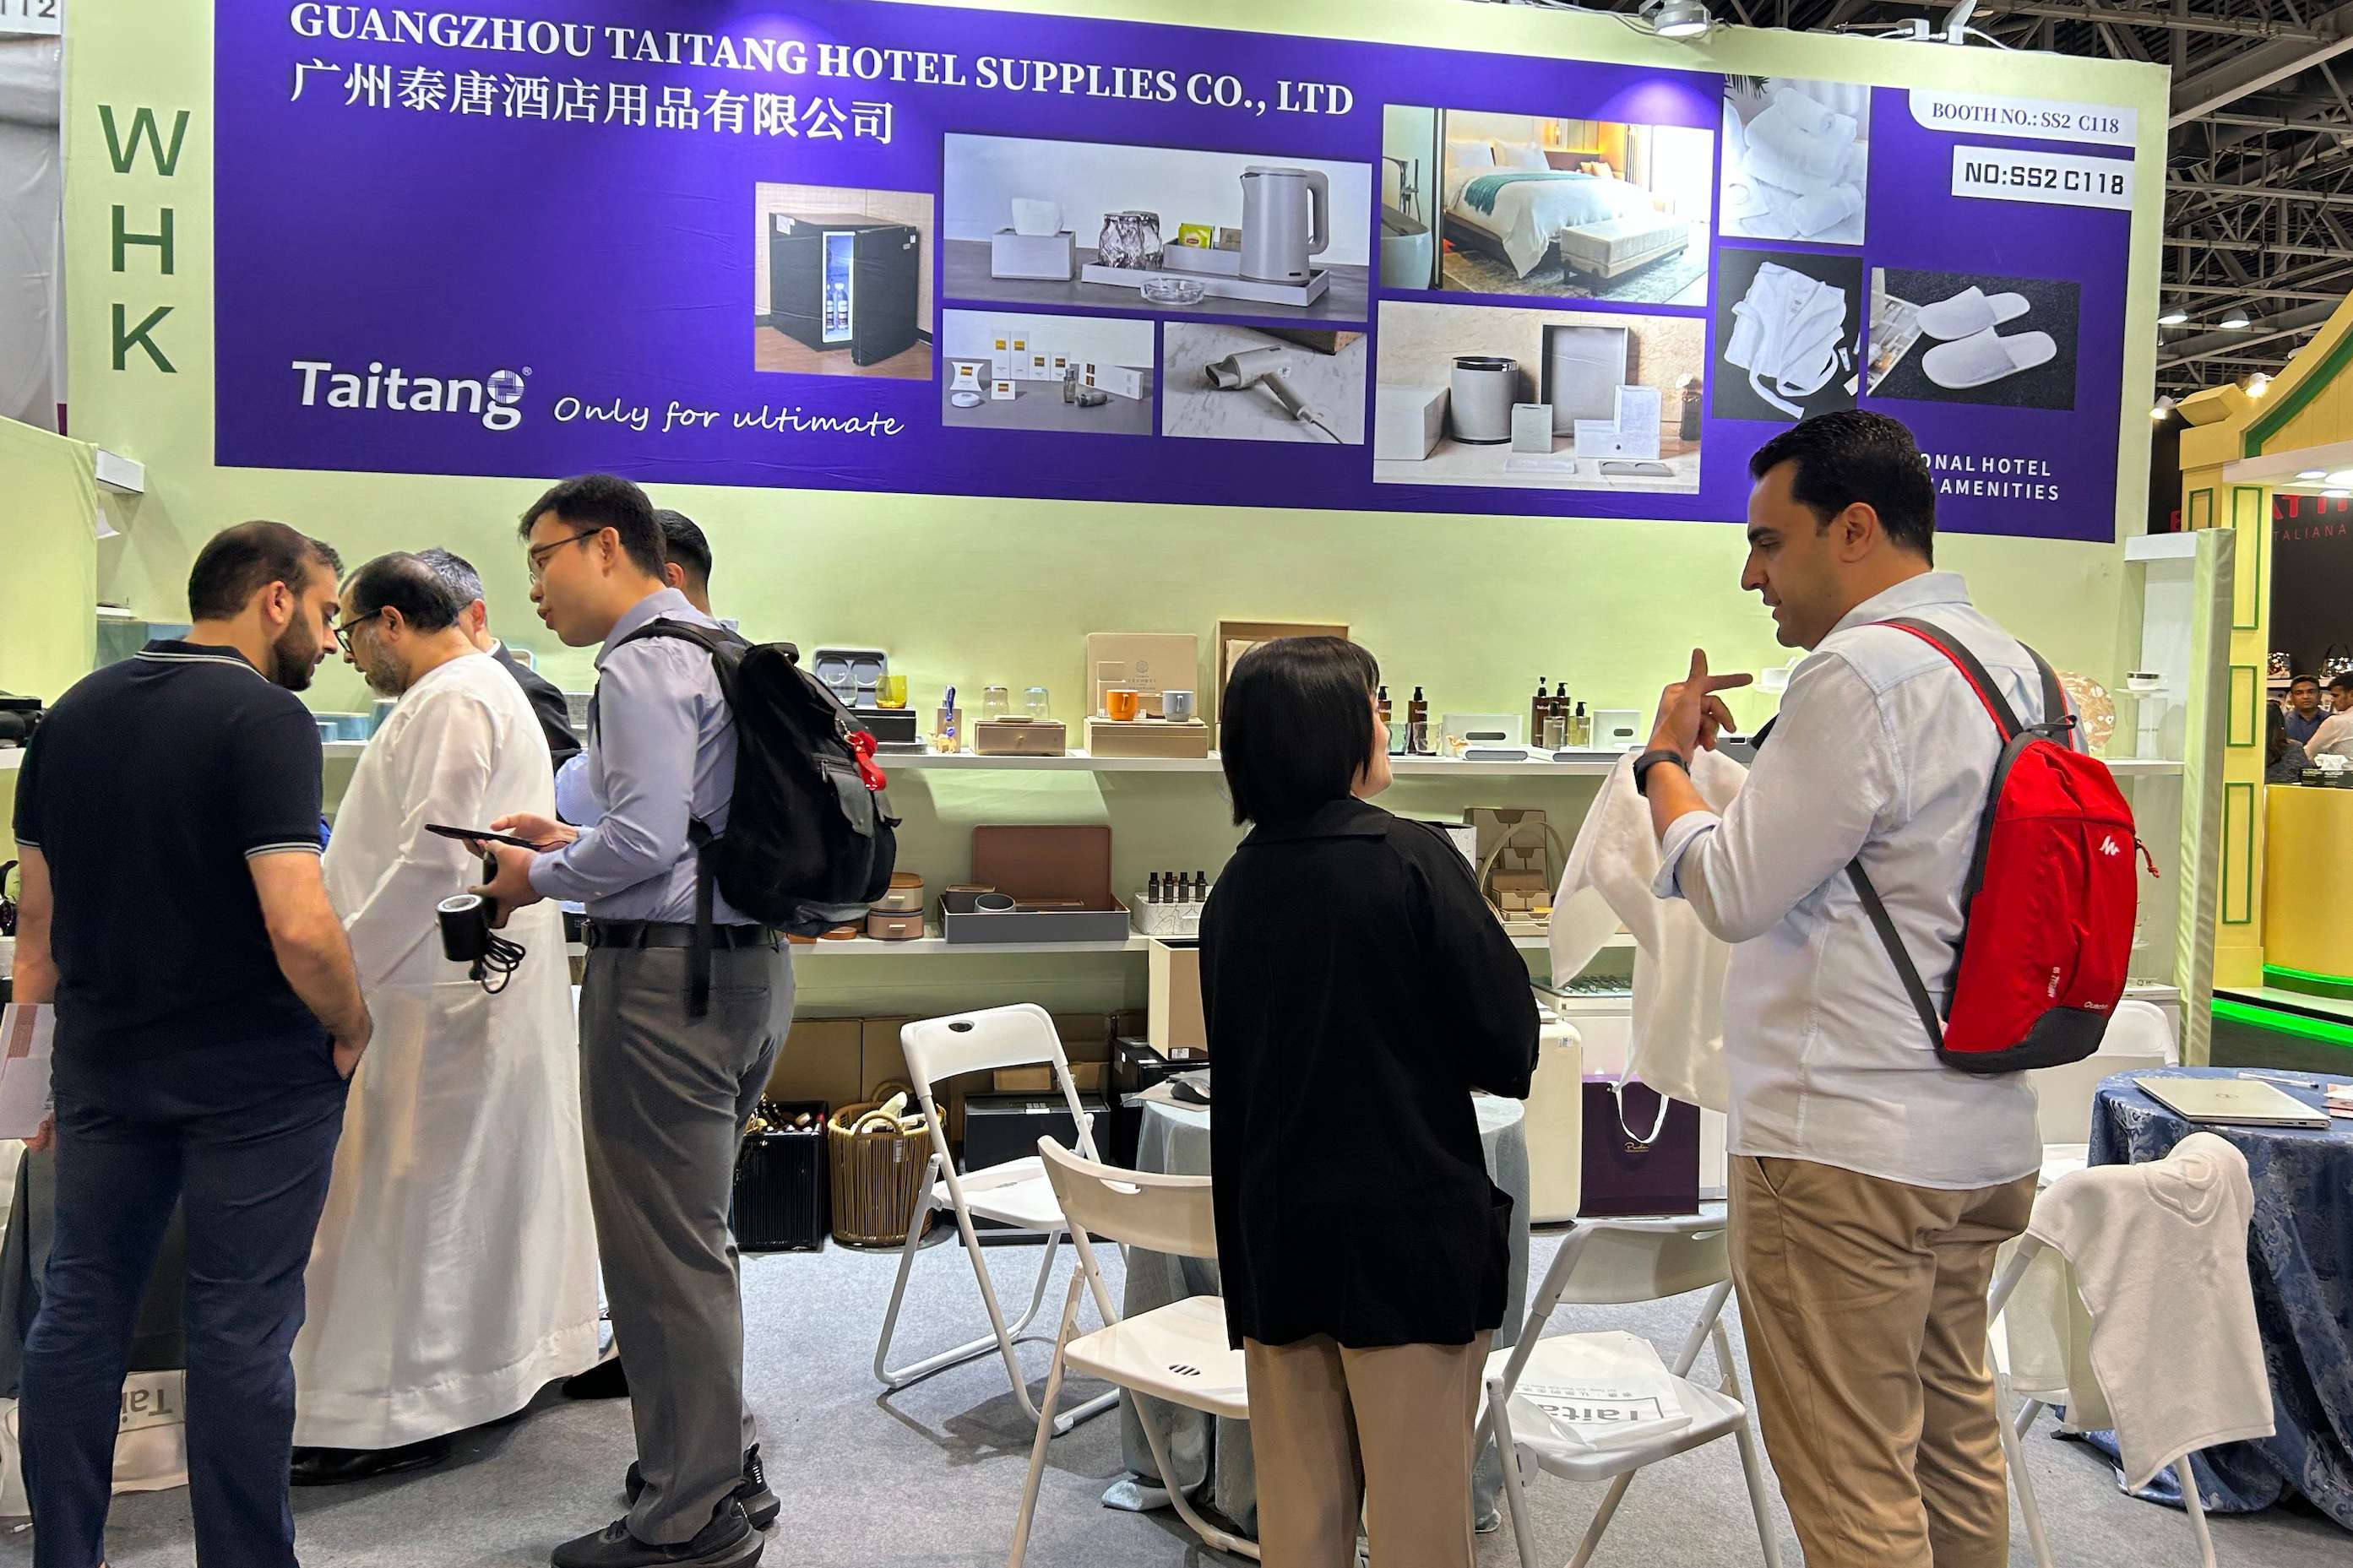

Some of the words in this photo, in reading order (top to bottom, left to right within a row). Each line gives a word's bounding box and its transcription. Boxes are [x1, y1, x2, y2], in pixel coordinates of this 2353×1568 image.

[291, 3, 595, 57] GUANGZHOU
[605, 27, 808, 75] TAITANG
[816, 43, 966, 86] HOTEL
[975, 56, 1177, 102] SUPPLIES
[1187, 73, 1266, 117] CO.,
[1276, 80, 1354, 115] LTD
[291, 57, 894, 145] 广州泰唐酒店用品有限公司
[1932, 102, 1997, 122] BOOTH
[2078, 115, 2120, 133] C118
[2064, 171, 2124, 195] C118
[291, 361, 526, 431] Taitang
[553, 397, 649, 431] Only
[661, 400, 720, 433] for
[732, 404, 905, 437] ultimate
[1981, 457, 2051, 476] HOTEL
[1939, 478, 2059, 501] AMENITIES
